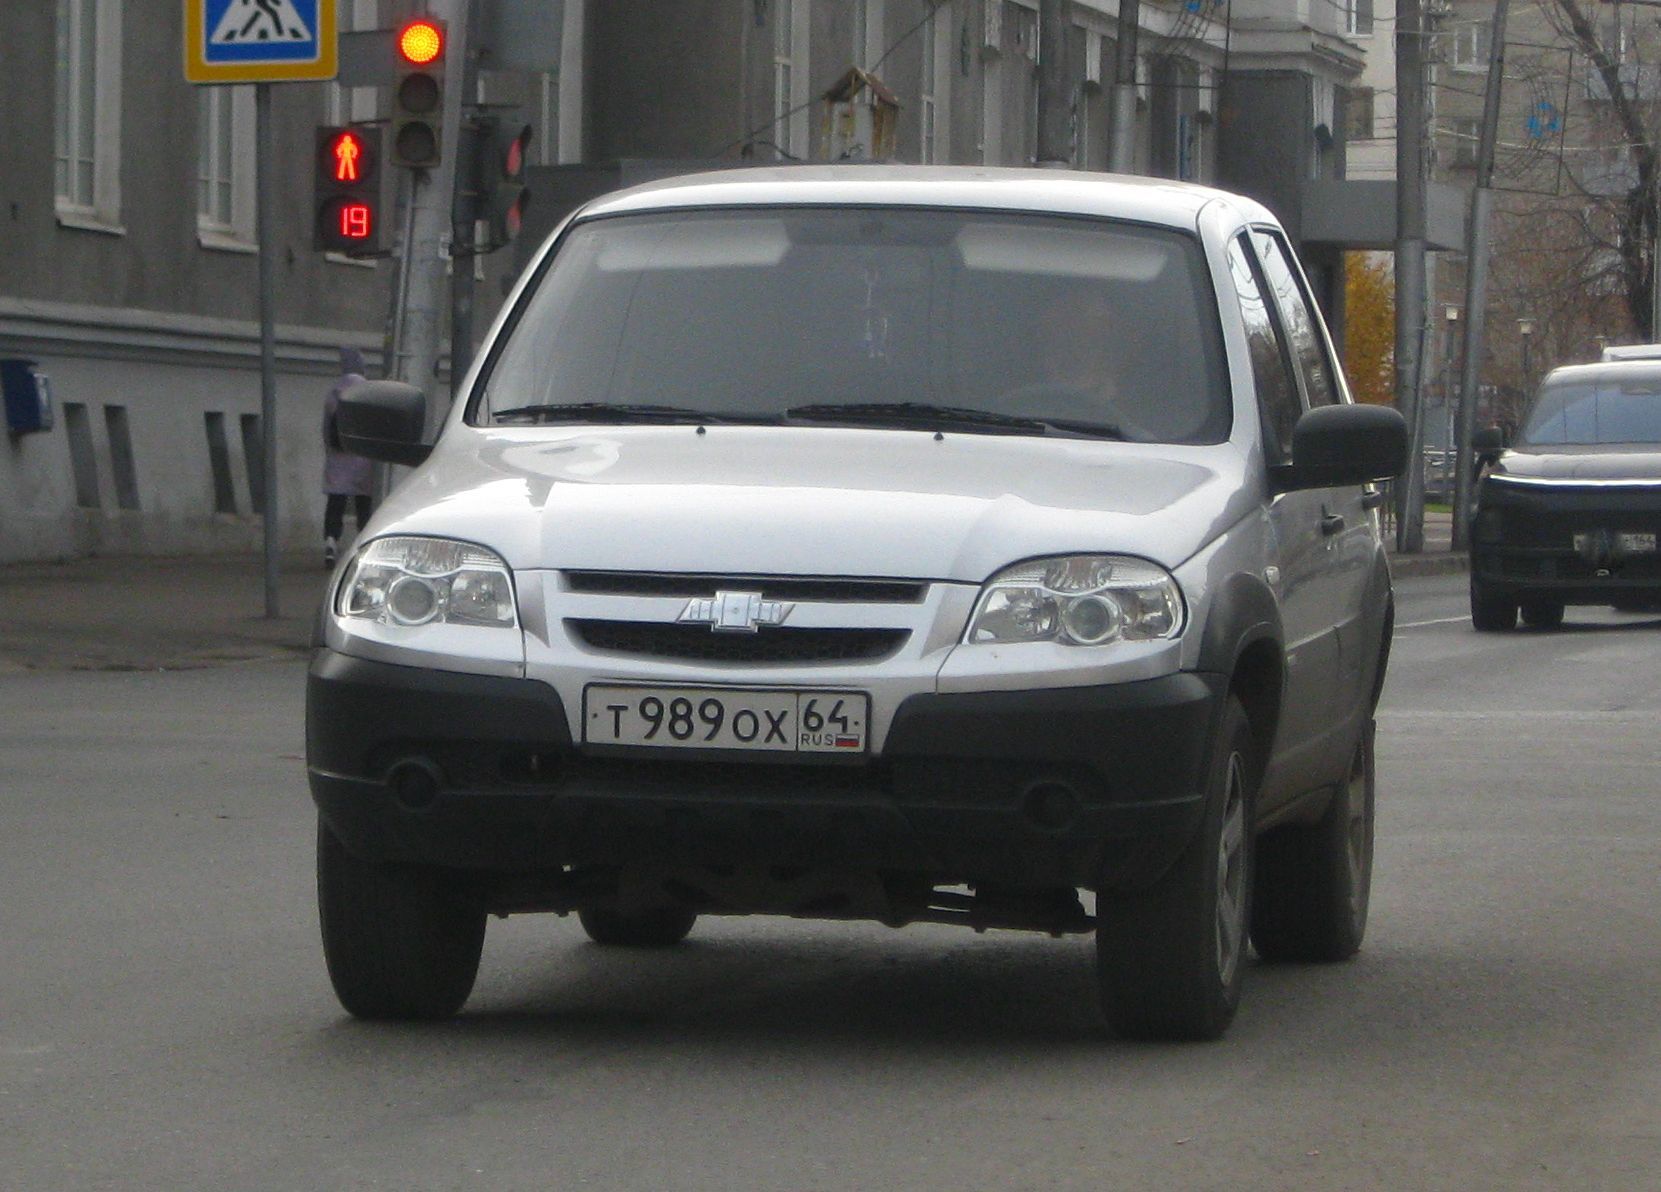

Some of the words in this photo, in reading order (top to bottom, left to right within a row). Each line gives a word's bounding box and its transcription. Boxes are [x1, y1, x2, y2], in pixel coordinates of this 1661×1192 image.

[342, 205, 369, 237] 19
[606, 696, 789, 744] Т989ОХ
[802, 698, 849, 734] 64
[800, 733, 834, 746] RUS
